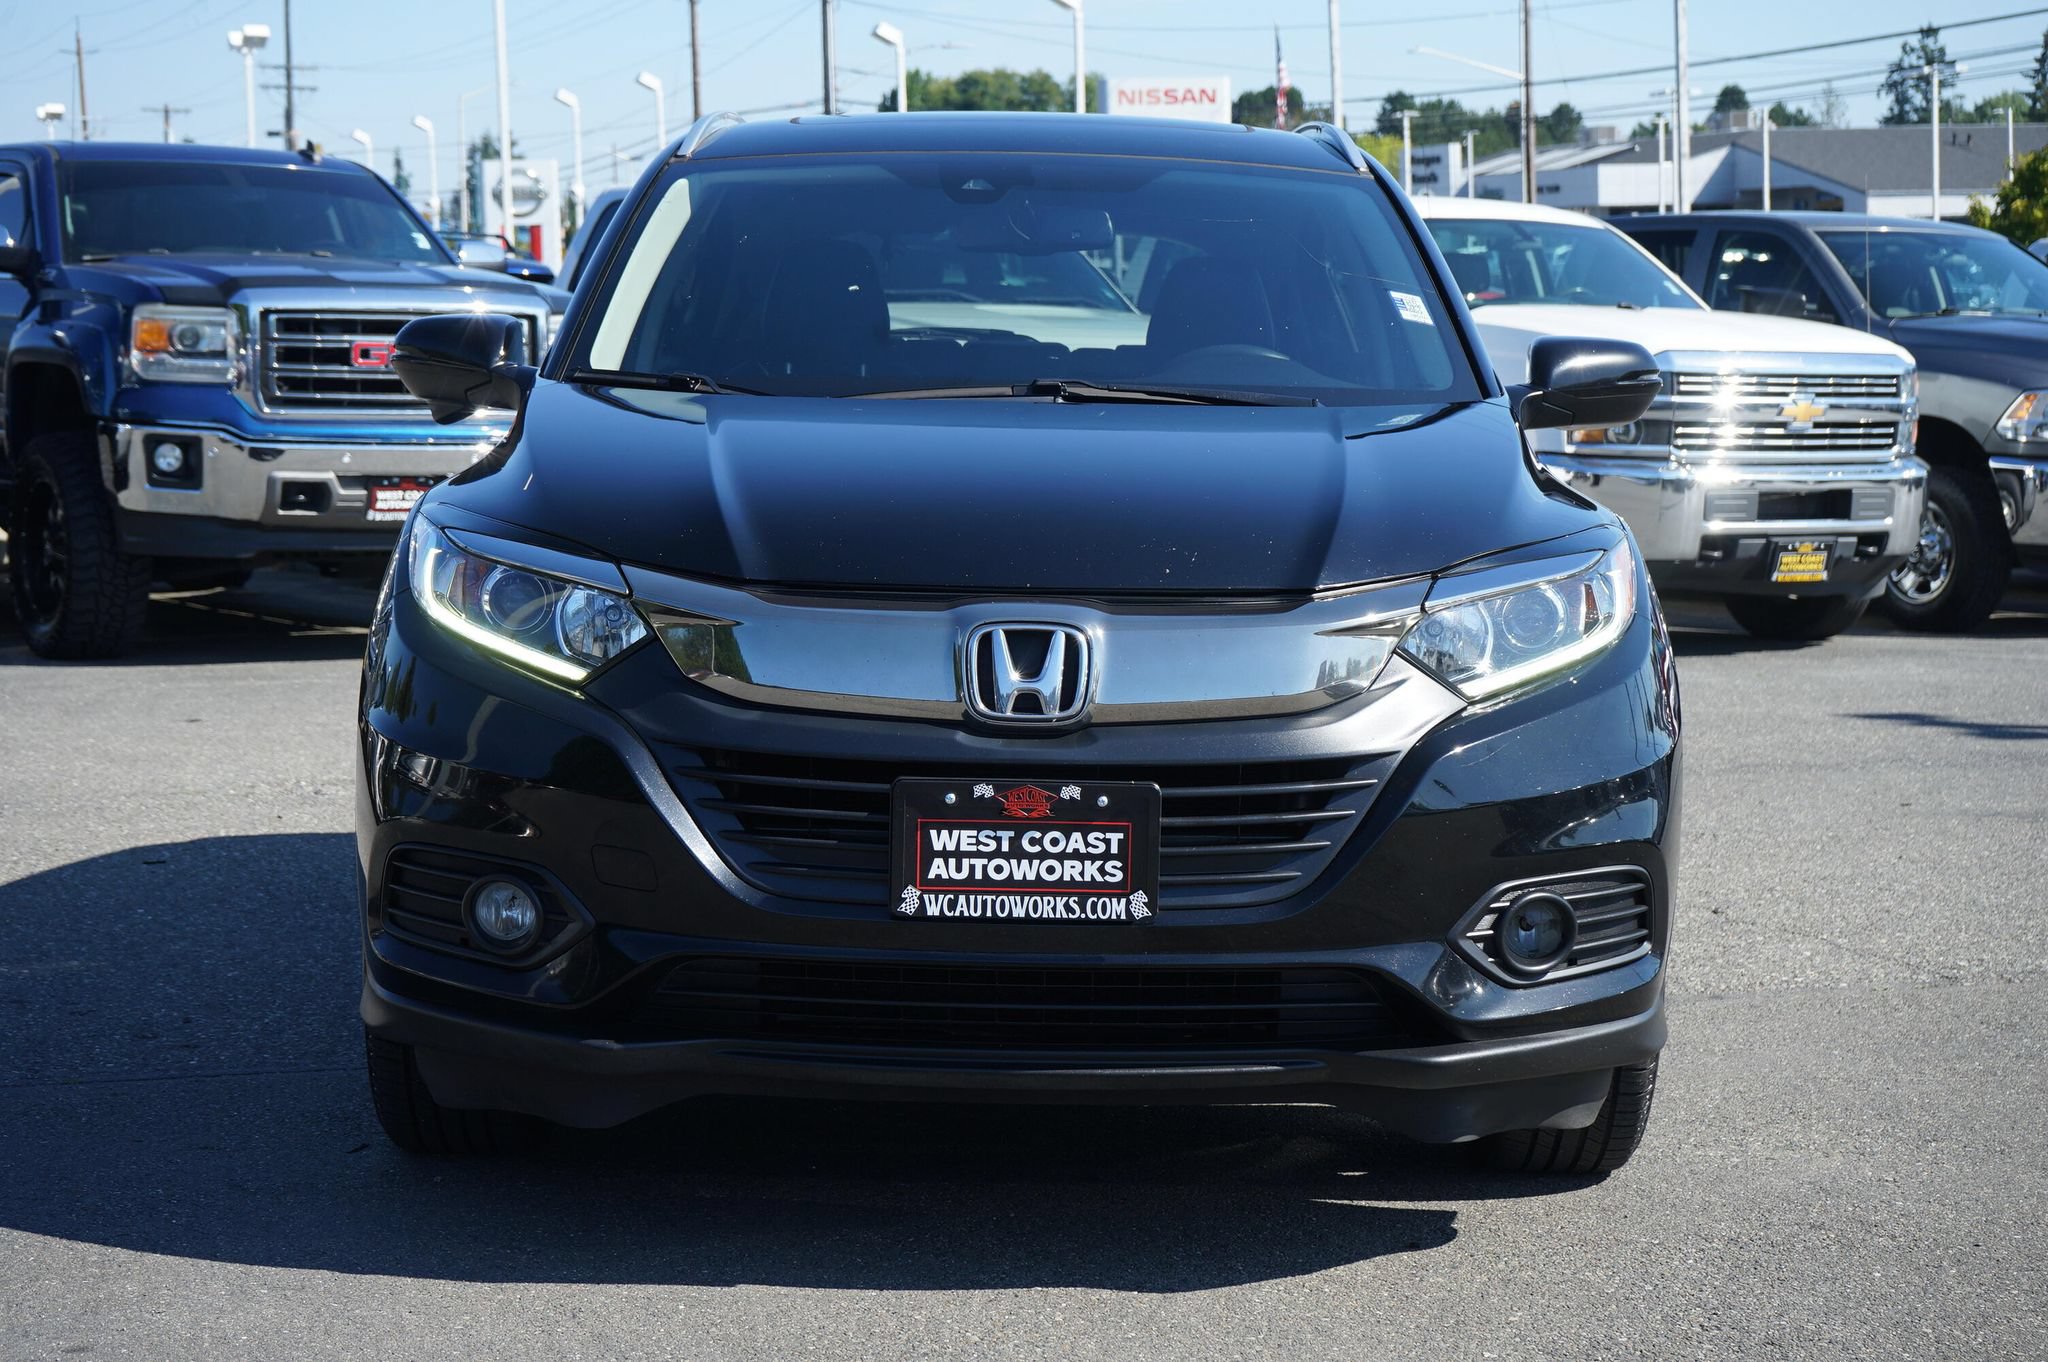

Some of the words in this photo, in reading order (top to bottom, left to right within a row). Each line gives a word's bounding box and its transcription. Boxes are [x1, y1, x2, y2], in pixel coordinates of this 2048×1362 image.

[1118, 88, 1217, 105] NISSAN
[1007, 788, 1027, 803] WEST
[1026, 788, 1048, 804] COAST
[929, 829, 1015, 853] WEST
[1021, 830, 1124, 855] COAST
[927, 857, 1124, 883] AUTOWORKS
[923, 893, 1127, 920] WCAUTOWORKS.COM
